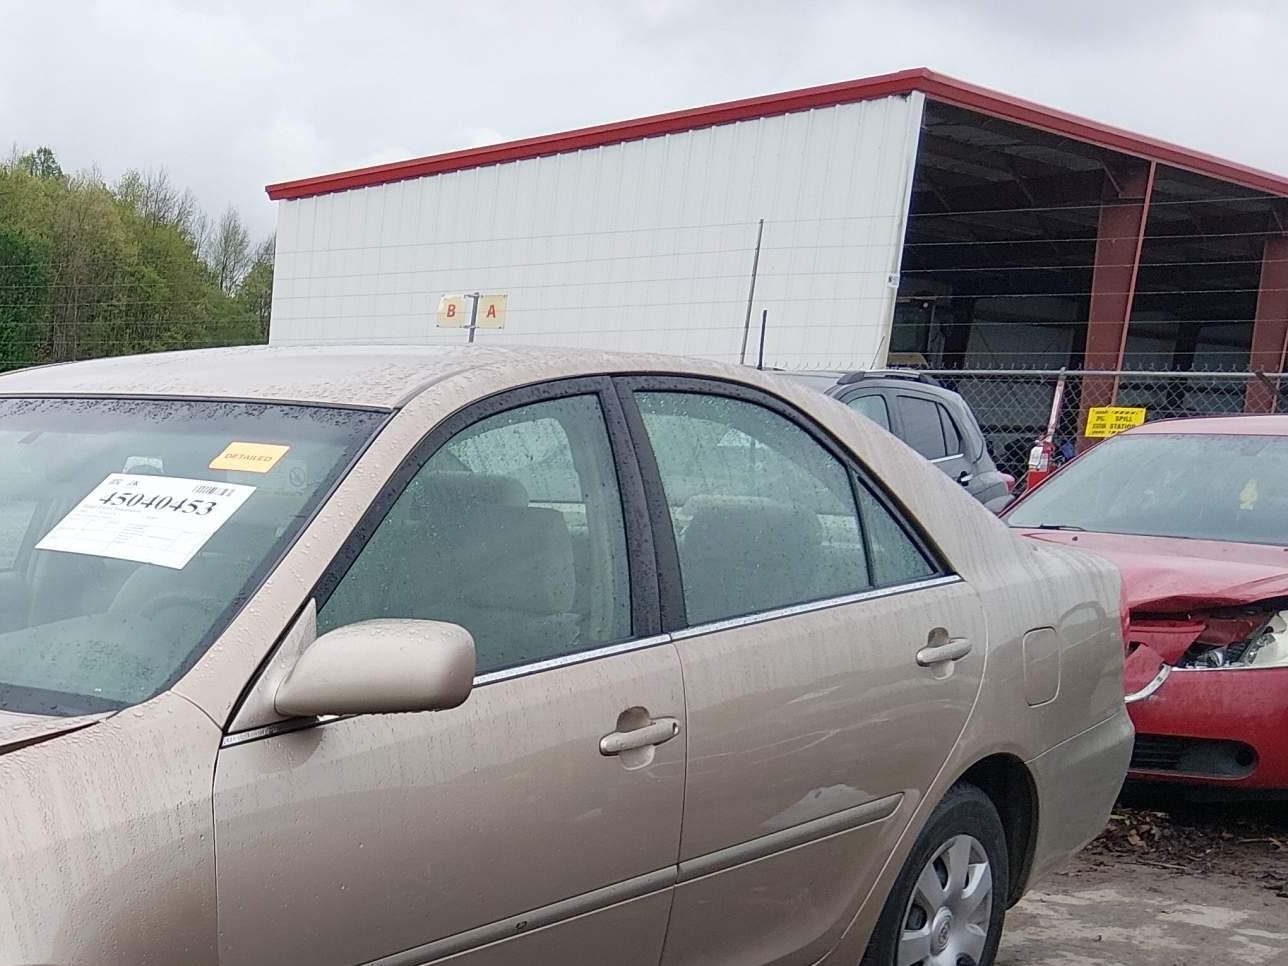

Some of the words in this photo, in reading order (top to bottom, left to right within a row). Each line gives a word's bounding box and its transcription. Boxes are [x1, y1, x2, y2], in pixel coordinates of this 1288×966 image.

[446, 304, 457, 318] B
[486, 304, 497, 319] A
[224, 453, 273, 462] DETAILED
[98, 490, 218, 517] 45040453
